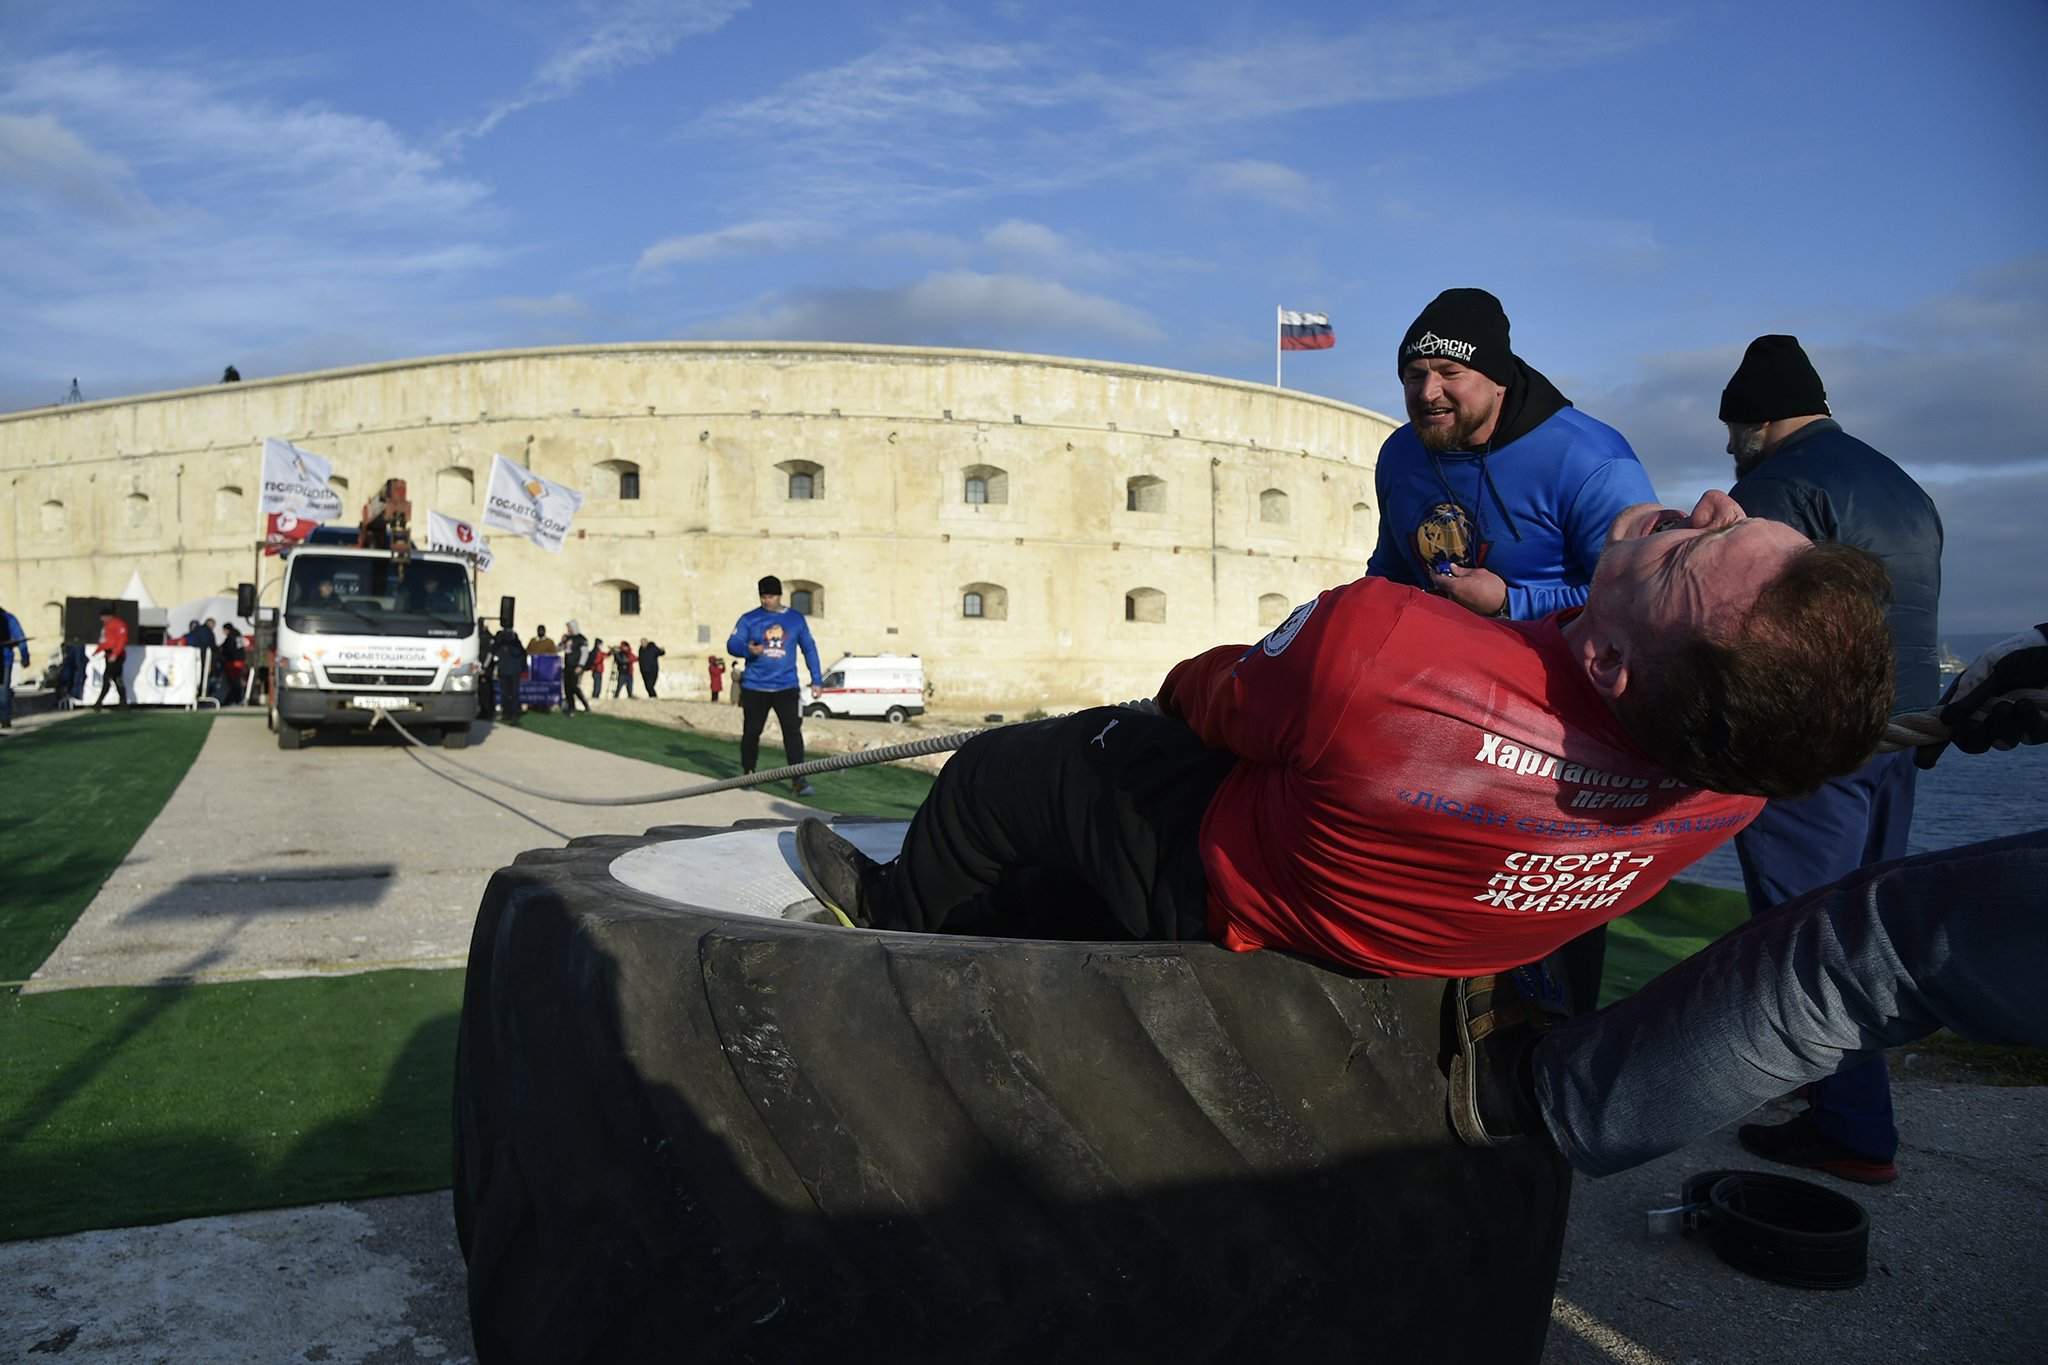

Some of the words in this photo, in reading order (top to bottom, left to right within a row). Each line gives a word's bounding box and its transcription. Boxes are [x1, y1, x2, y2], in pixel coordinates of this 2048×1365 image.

[1474, 733, 1649, 789] Харламов
[1487, 870, 1641, 893] НОРМА
[1473, 888, 1624, 912] ЖИЗНИ
